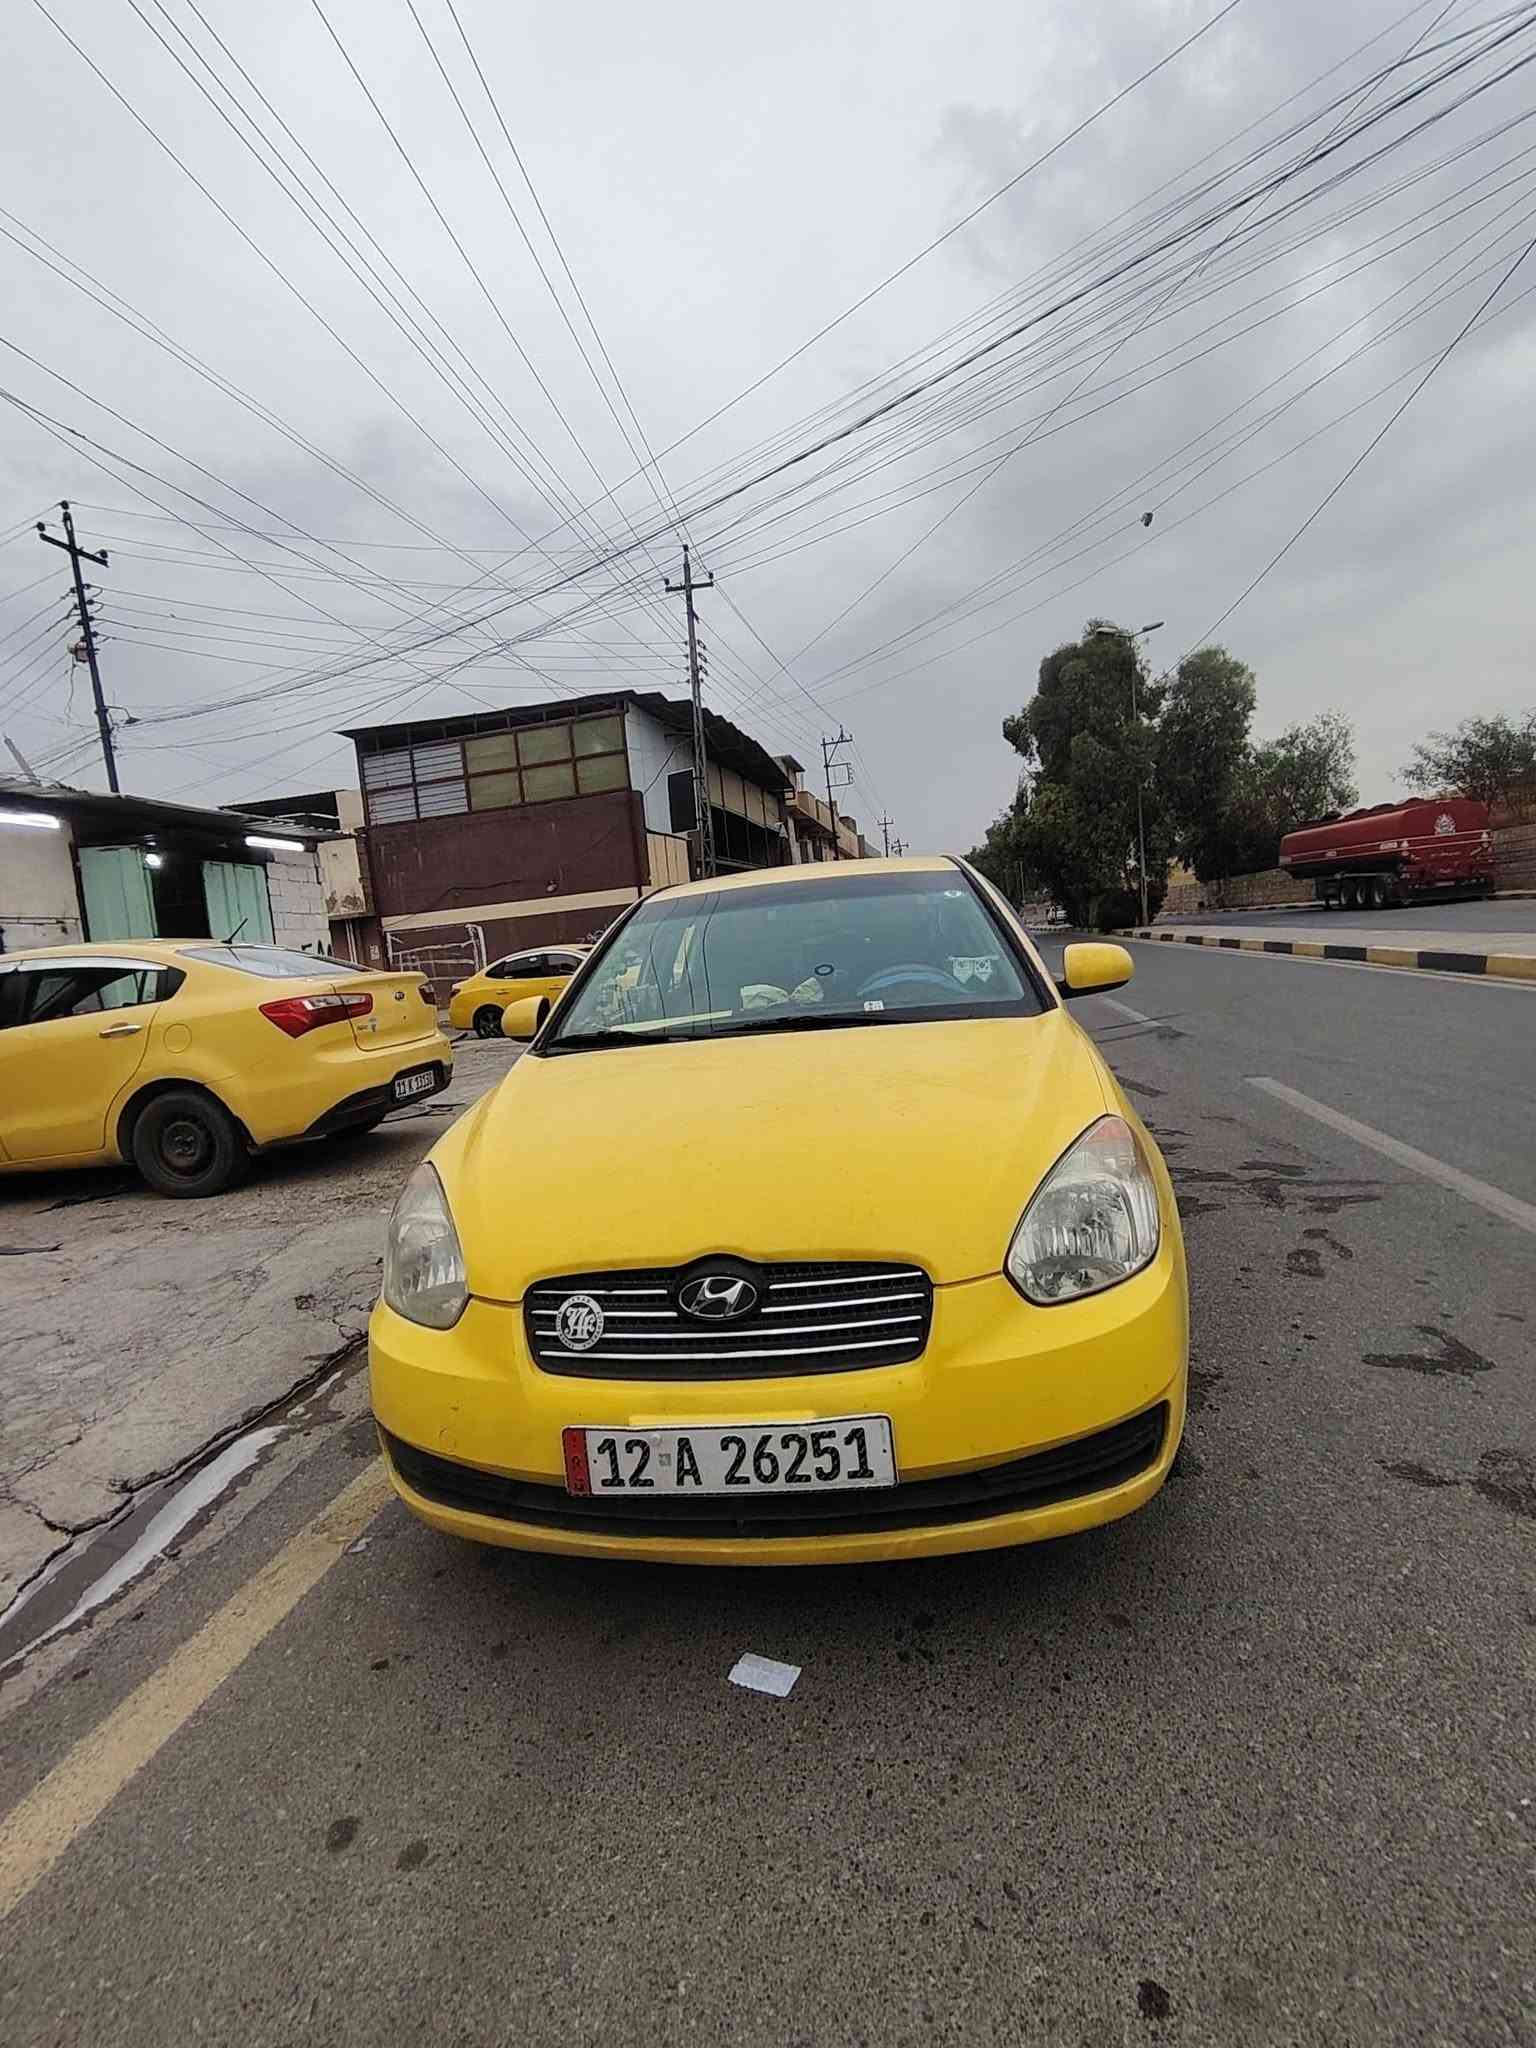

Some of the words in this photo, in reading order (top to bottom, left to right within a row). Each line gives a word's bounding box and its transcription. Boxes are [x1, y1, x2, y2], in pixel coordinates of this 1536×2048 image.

[597, 1438, 654, 1487] 12
[676, 1437, 702, 1486] A
[720, 1427, 874, 1485] 26251
